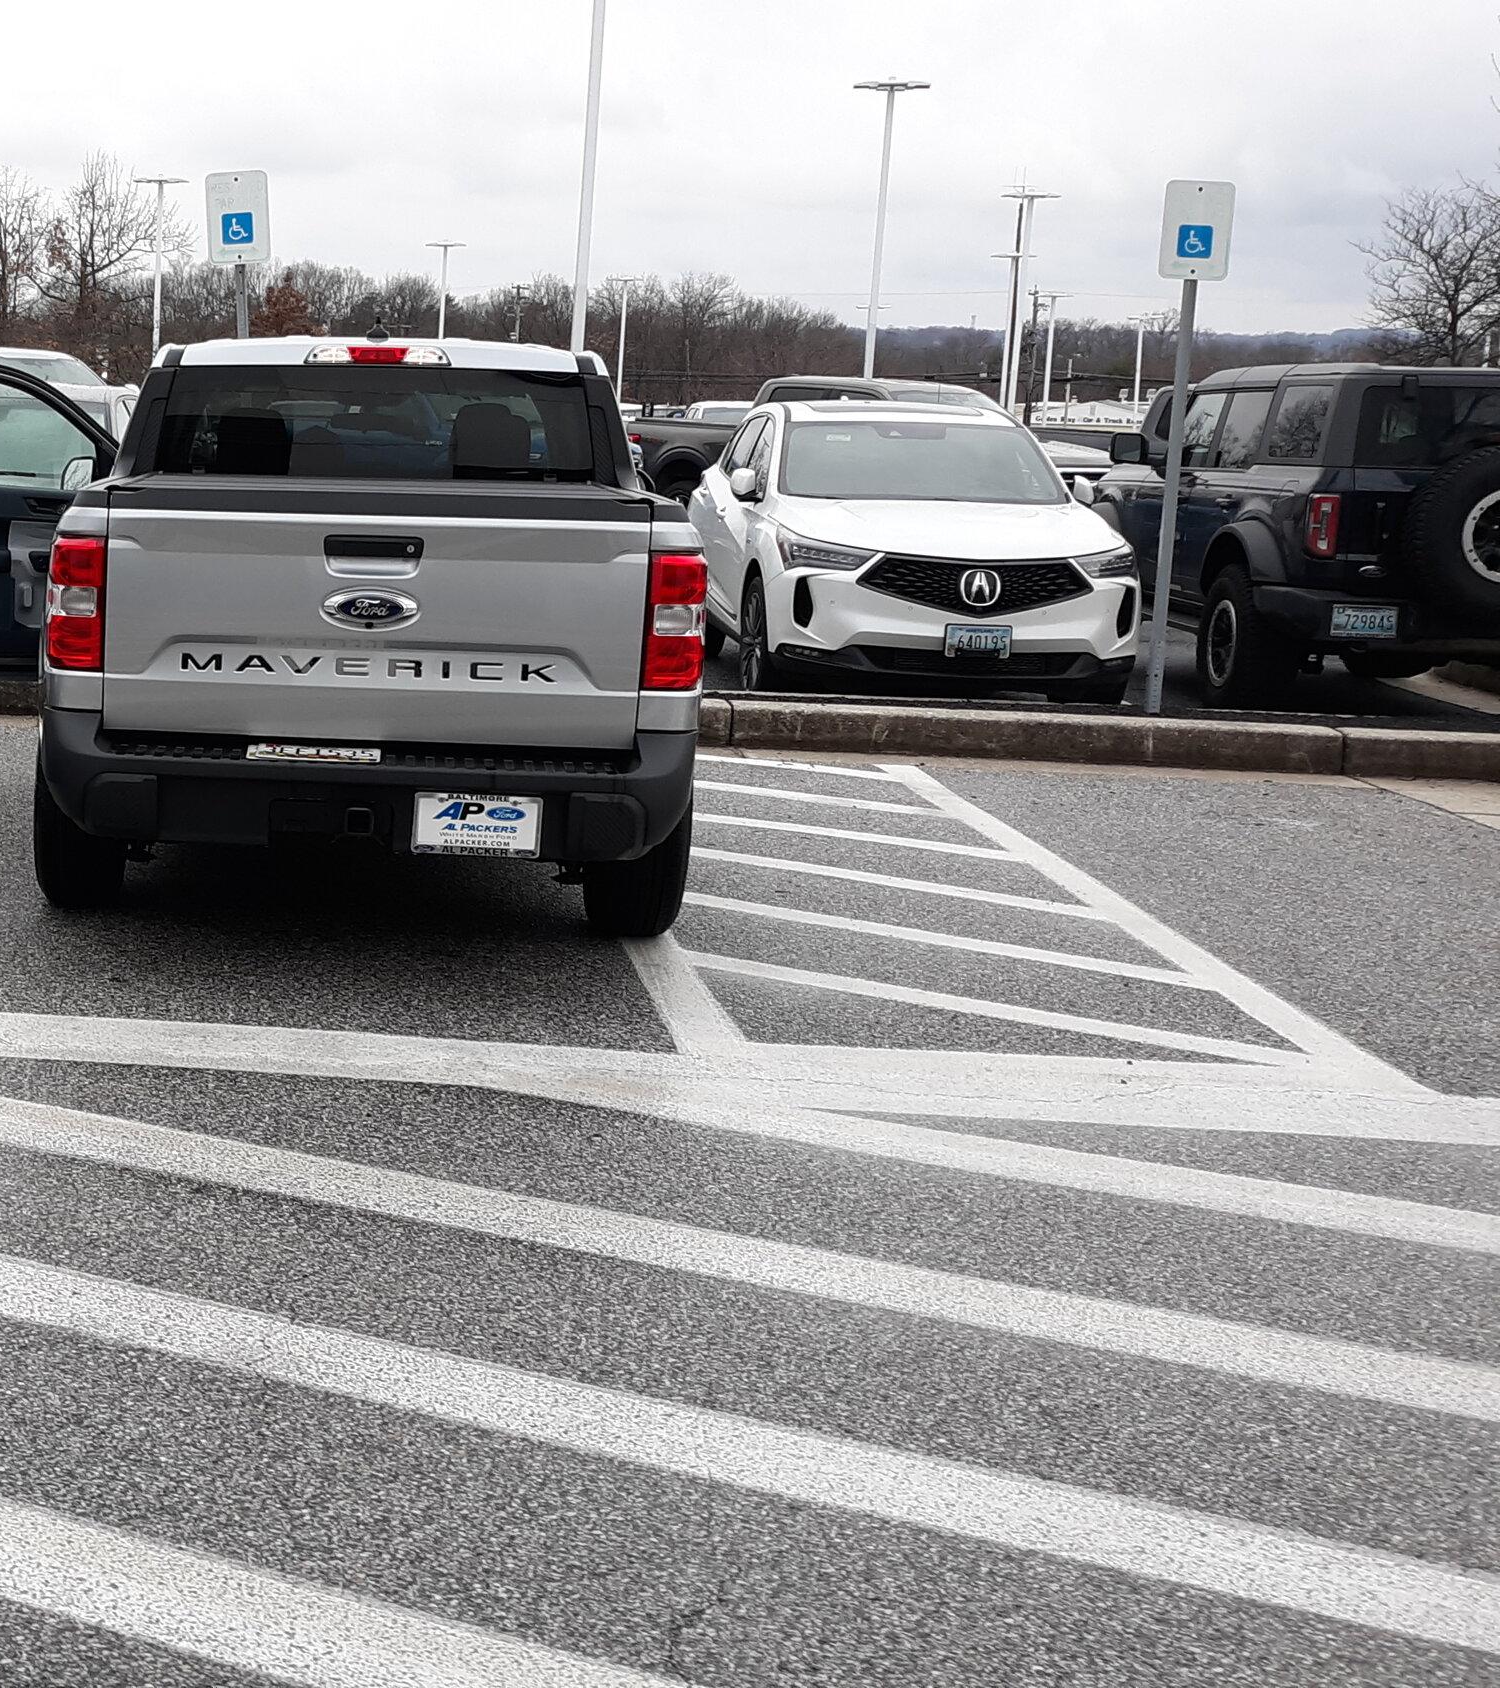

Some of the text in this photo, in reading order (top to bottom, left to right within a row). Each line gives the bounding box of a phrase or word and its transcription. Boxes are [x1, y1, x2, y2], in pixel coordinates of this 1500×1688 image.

[350, 598, 390, 617] Ford
[180, 652, 558, 684] MAVERICK
[448, 793, 511, 803] BALTIMORE
[432, 801, 518, 821] AP Ford
[441, 823, 459, 831] AL
[443, 838, 511, 848] ALPACKER.COM
[441, 846, 456, 854] AL
[459, 847, 509, 857] PACKER
